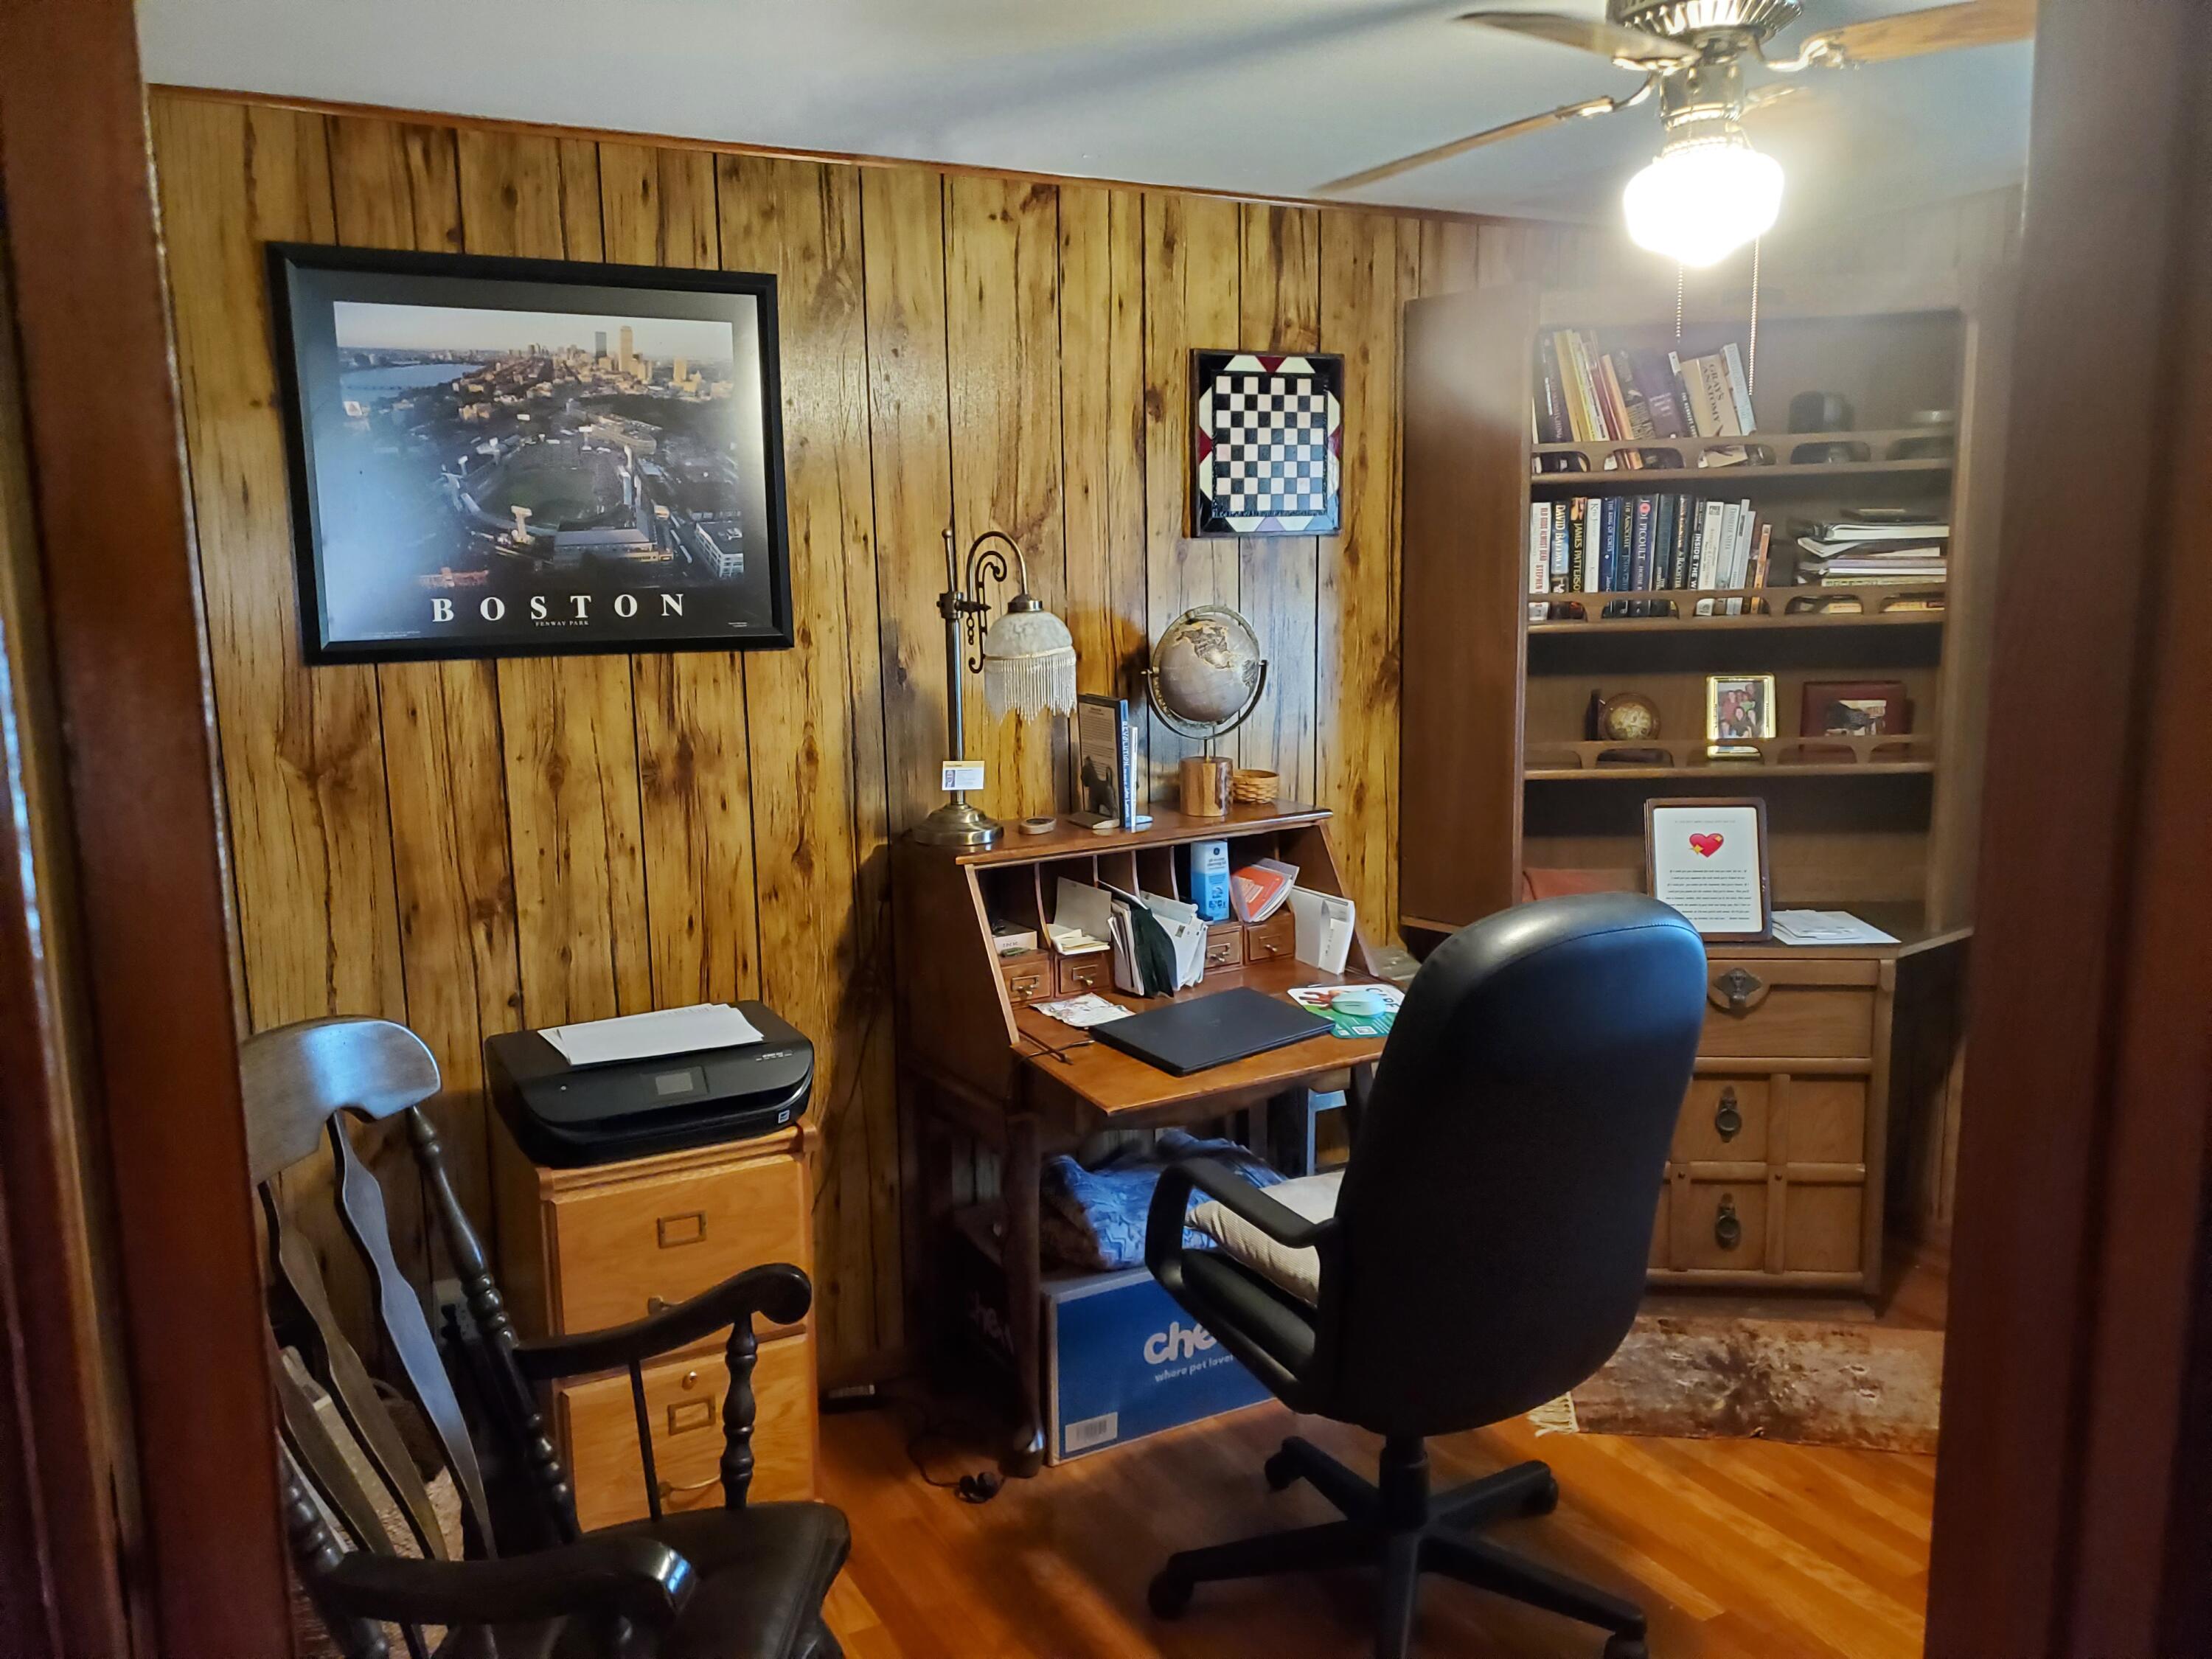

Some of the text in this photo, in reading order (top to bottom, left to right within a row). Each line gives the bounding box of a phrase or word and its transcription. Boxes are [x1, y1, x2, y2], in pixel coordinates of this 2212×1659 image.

[1702, 366, 1721, 423] ANATOMY
[1708, 364, 1725, 401] GRAY'S
[1555, 505, 1566, 530] DAVID
[1573, 523, 1583, 593] JAMES PATTERSO
[1638, 523, 1648, 560] PICOULT
[1694, 533, 1702, 560] INSIDE
[1535, 564, 1544, 590] STEPHEN
[431, 593, 684, 622] BOSTON
[1121, 720, 1130, 766] REVOLUTION
[1144, 1321, 1217, 1364] che
[1155, 1354, 1234, 1382] where pet lover
